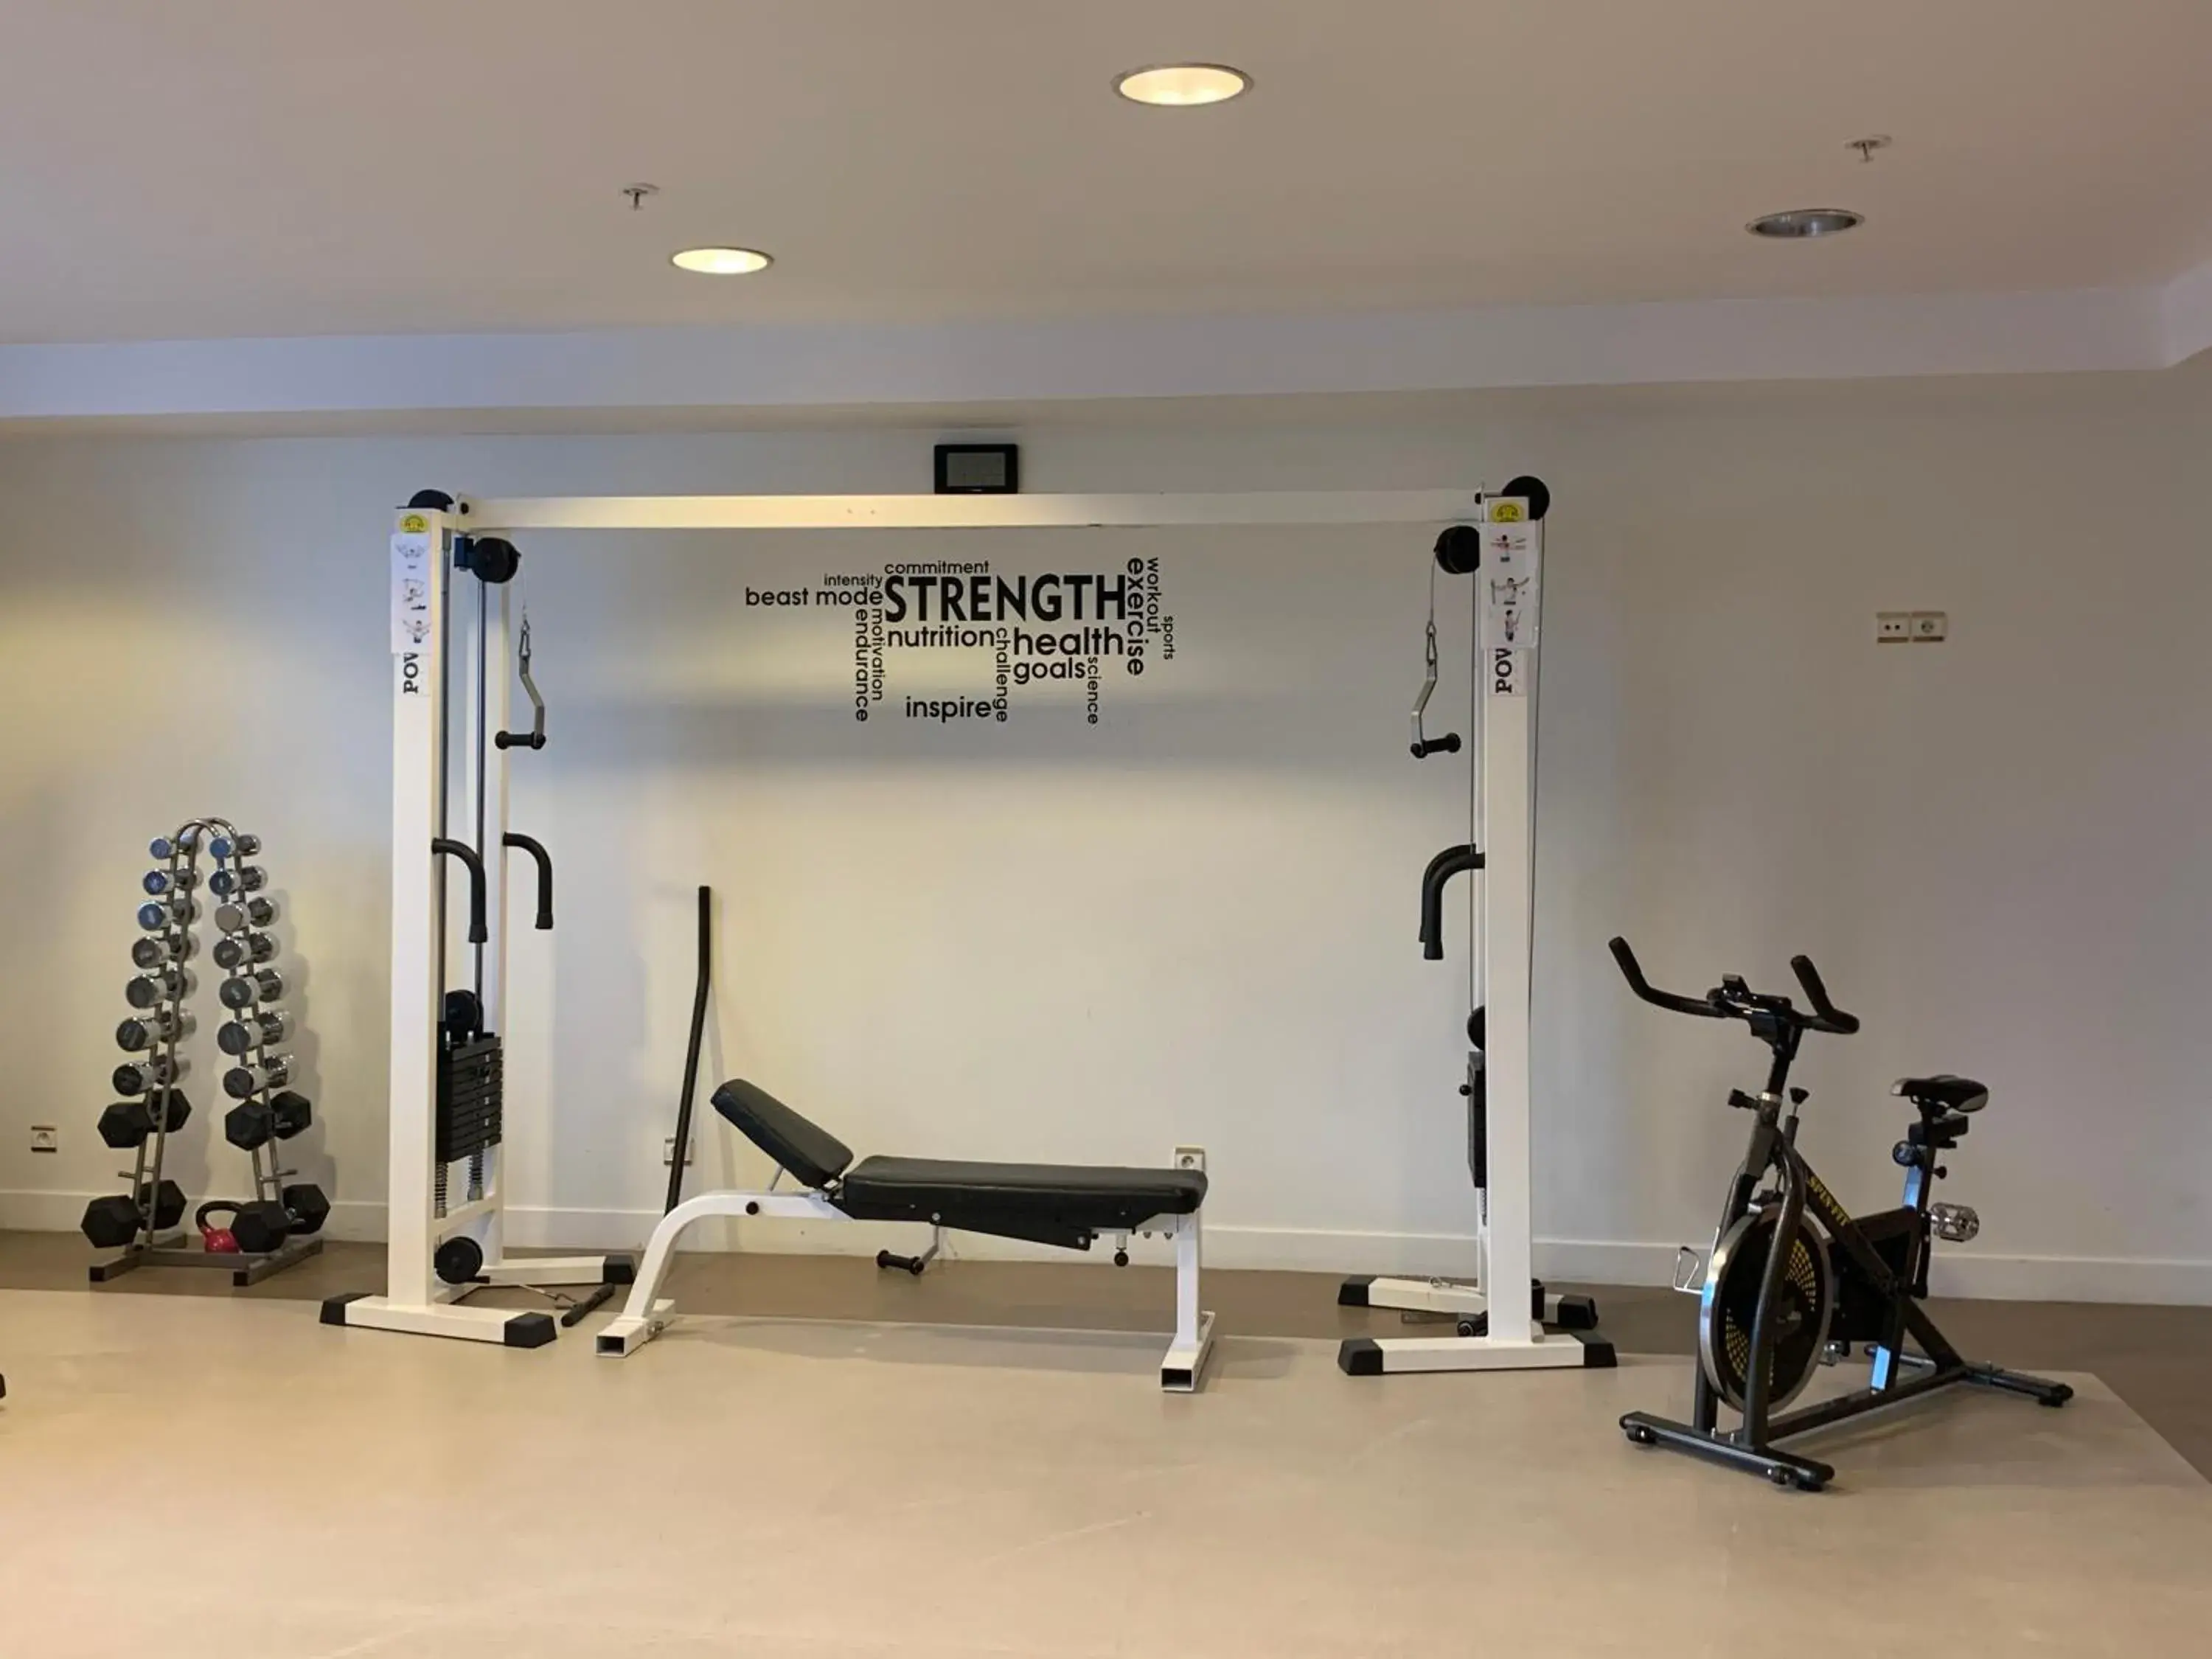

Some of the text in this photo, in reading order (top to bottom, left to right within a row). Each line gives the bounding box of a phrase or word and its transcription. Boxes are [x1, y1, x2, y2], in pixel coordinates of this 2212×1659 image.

[824, 573, 883, 589] intensity
[884, 560, 989, 574] commitment
[745, 587, 884, 606] beast mode
[885, 574, 1126, 622] STRENGTH
[1127, 557, 1149, 676] exercise
[1147, 557, 1163, 633] workout
[872, 608, 886, 701] motivation
[888, 625, 995, 648] nutrition
[1013, 627, 1124, 655] health
[1161, 615, 1176, 661] sports
[855, 608, 871, 722] endurance
[992, 627, 1011, 723] challenge
[1013, 657, 1086, 685] goals
[905, 696, 992, 723] inspire
[1087, 656, 1102, 725] science
